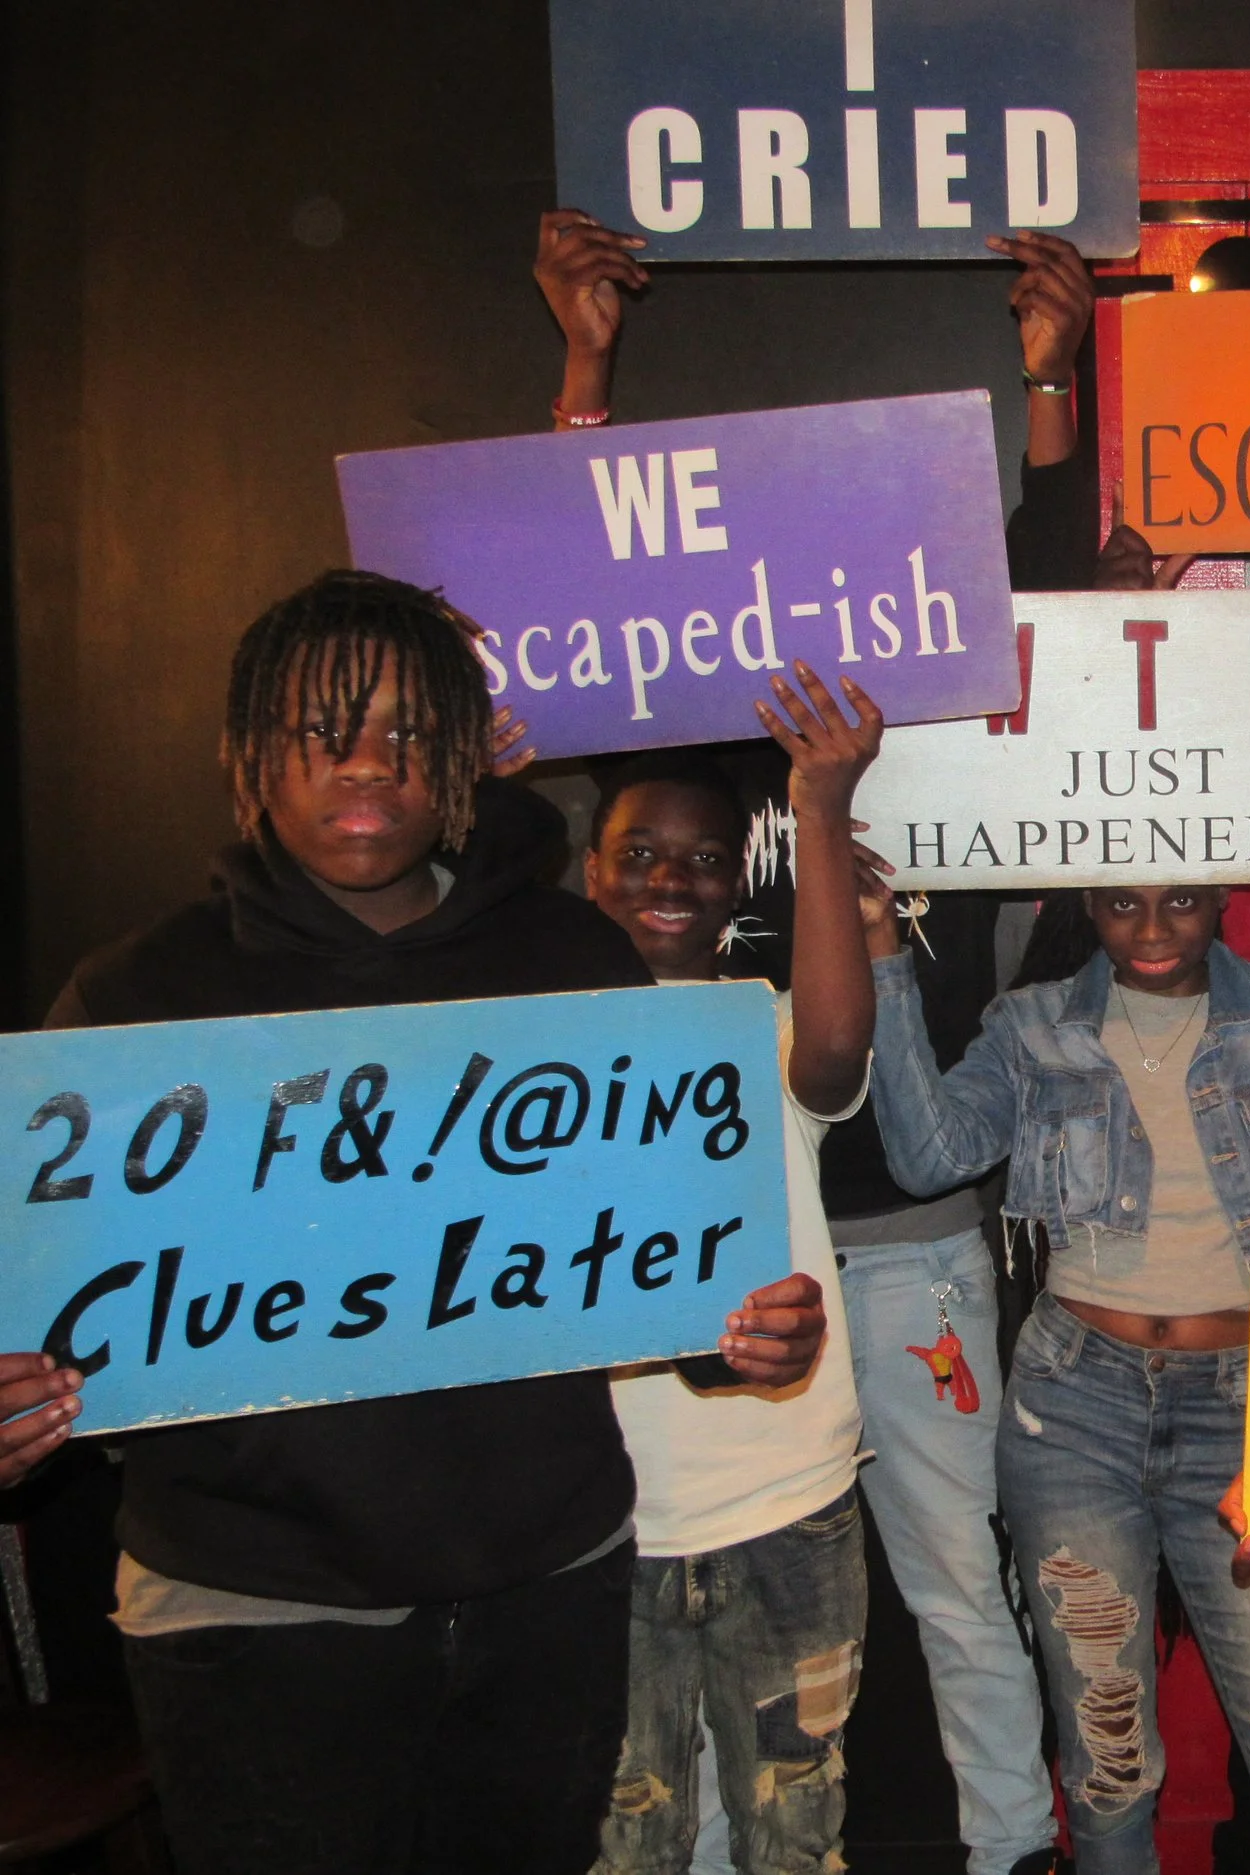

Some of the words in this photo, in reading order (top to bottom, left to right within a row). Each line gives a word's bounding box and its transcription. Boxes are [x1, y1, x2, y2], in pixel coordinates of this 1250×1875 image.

[844, 0, 875, 91] I
[626, 107, 1079, 233] CRIED
[589, 447, 730, 561] WE
[474, 544, 967, 722] scaped-ish
[1061, 747, 1225, 799] JUST
[25, 1083, 209, 1204] 20
[42, 1246, 397, 1378] Clues
[426, 1206, 743, 1331] Later
